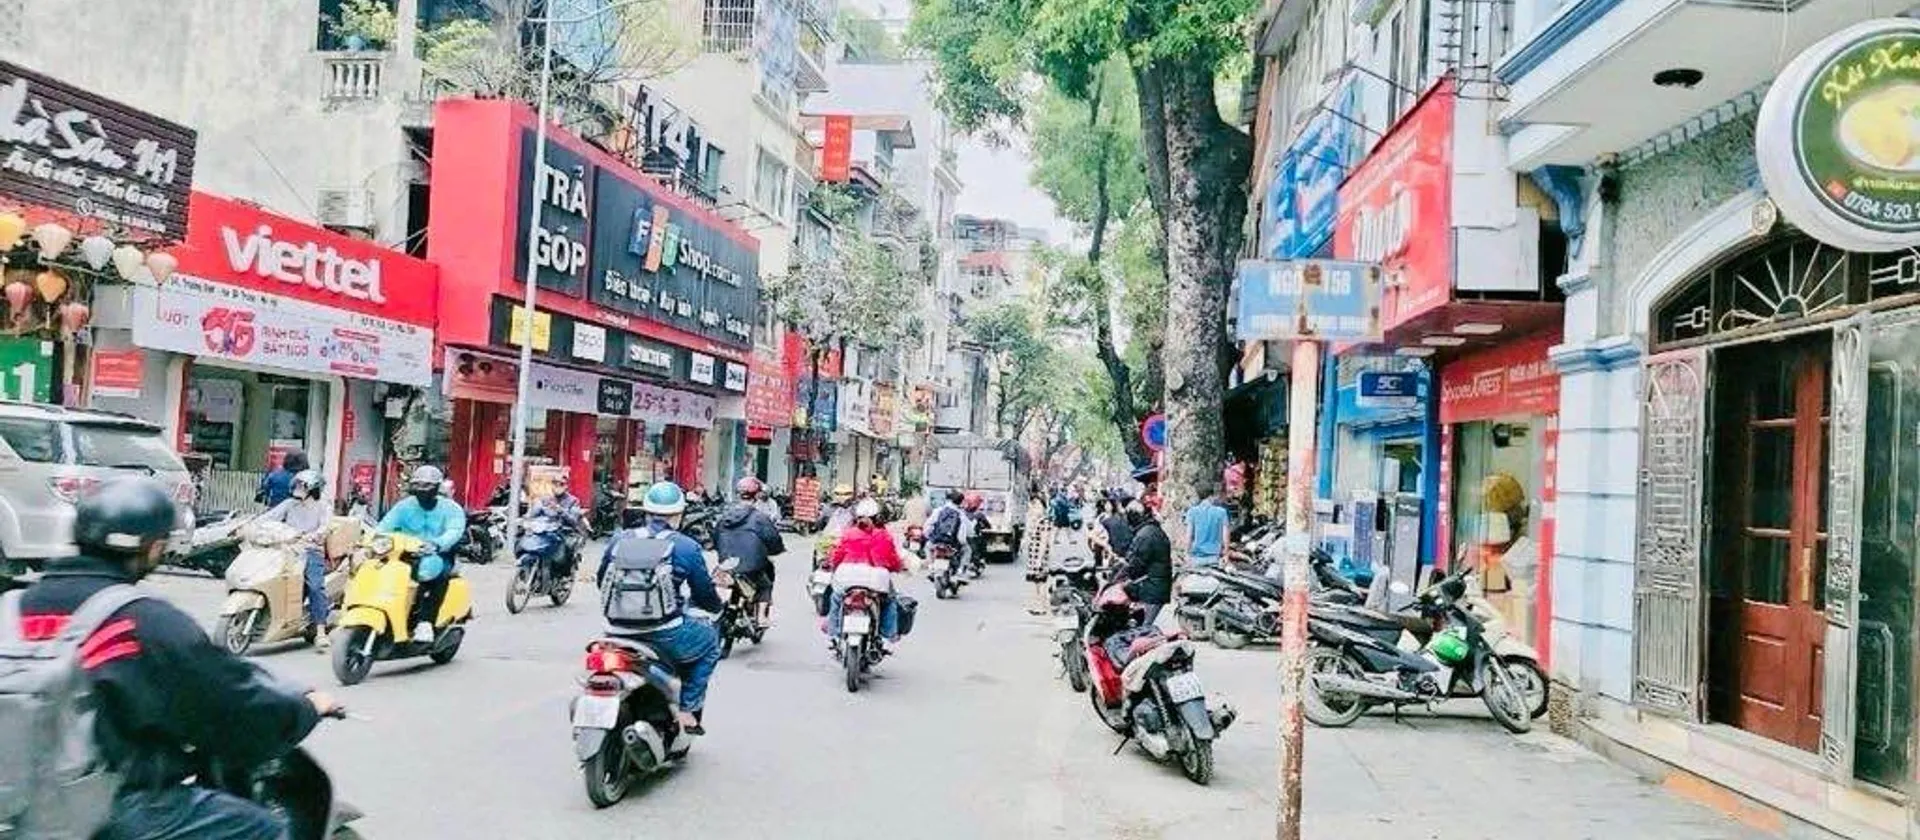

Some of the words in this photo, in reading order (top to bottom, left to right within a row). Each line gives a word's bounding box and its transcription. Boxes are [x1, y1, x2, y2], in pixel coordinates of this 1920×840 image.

[536, 164, 588, 219] TRẢ
[1844, 191, 1880, 218] 0784
[1883, 202, 1912, 221] 520
[536, 225, 587, 276] GÓP
